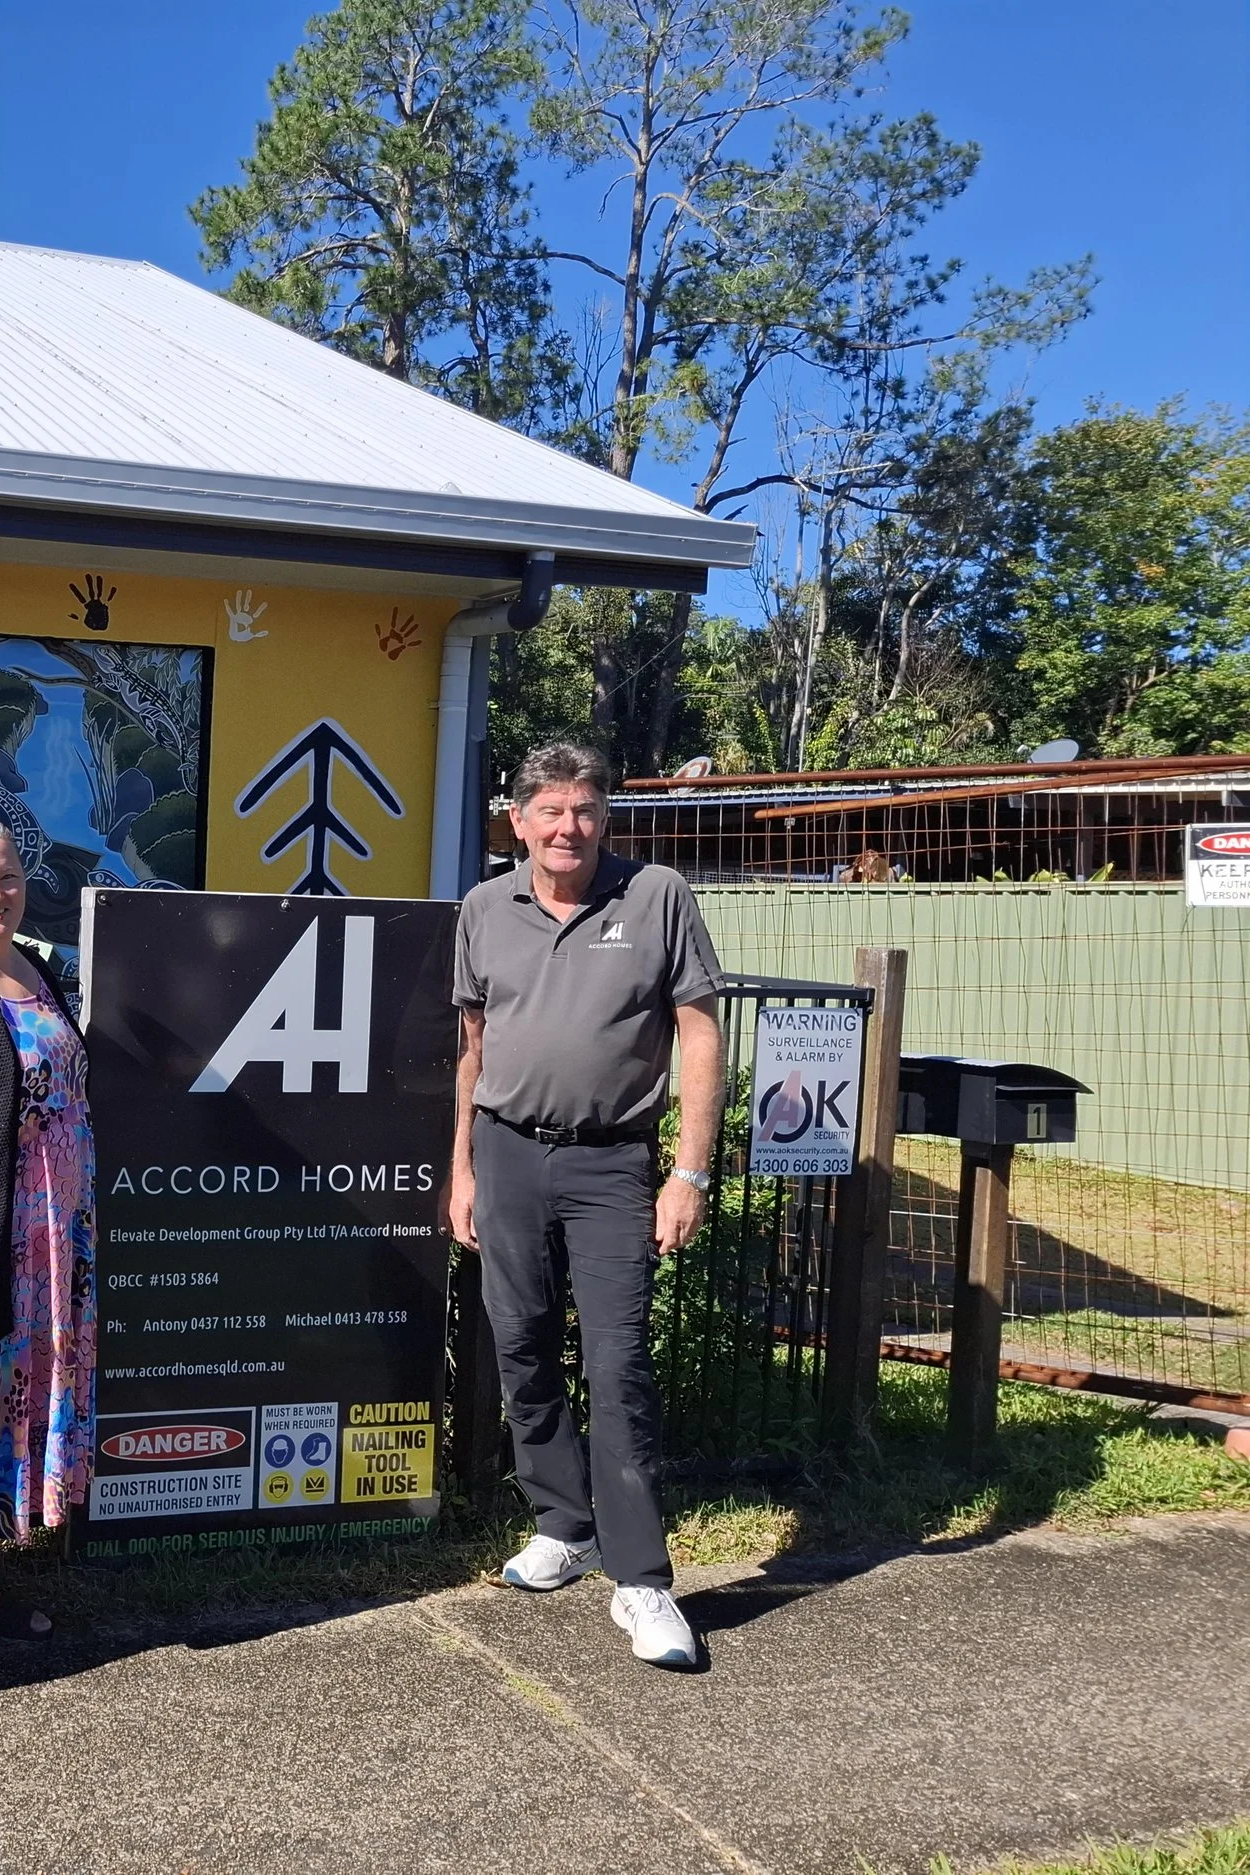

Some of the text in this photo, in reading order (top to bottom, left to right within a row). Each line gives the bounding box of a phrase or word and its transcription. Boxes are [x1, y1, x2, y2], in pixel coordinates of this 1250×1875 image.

[188, 914, 375, 1093] AH
[766, 1013, 857, 1032] WARNING
[768, 1037, 853, 1049] SURVEILLANCE
[775, 1051, 844, 1063] & ALARM BY
[1033, 1107, 1041, 1135] 1
[813, 1130, 850, 1141] SECURITY
[756, 1147, 849, 1156] www.aoksecurity.com.au
[754, 1158, 849, 1173] 1300 606 303
[111, 1163, 434, 1195] ACCORD HOMES
[110, 1223, 432, 1243] Elevate Development Group Pty Ltd T/A Accord Homes
[108, 1272, 219, 1290] QBCC #1503 5864
[107, 1310, 408, 1334] Ph: Antony 0437 112 558 Michael 0413 478 558
[104, 1360, 285, 1379] www.accordhomesqld.com.au
[265, 1405, 333, 1418] MUST BE WORN
[349, 1401, 430, 1424] CAUTION
[264, 1418, 335, 1431] WHEN REQUIRED
[118, 1430, 228, 1457] DANGER
[351, 1429, 426, 1452] NAILING
[364, 1452, 411, 1473] TOOL
[100, 1474, 242, 1498] CONSTRUCTION SITE
[356, 1474, 418, 1497] IN USE
[99, 1494, 242, 1516] NO UNAUTHORISED ENTRY
[87, 1539, 123, 1558] DIAL
[128, 1537, 158, 1556] 000
[162, 1533, 193, 1552] FOR
[198, 1528, 266, 1550] SERIOUS
[271, 1523, 327, 1544] INJURY
[339, 1516, 432, 1538] EMERGENCY
